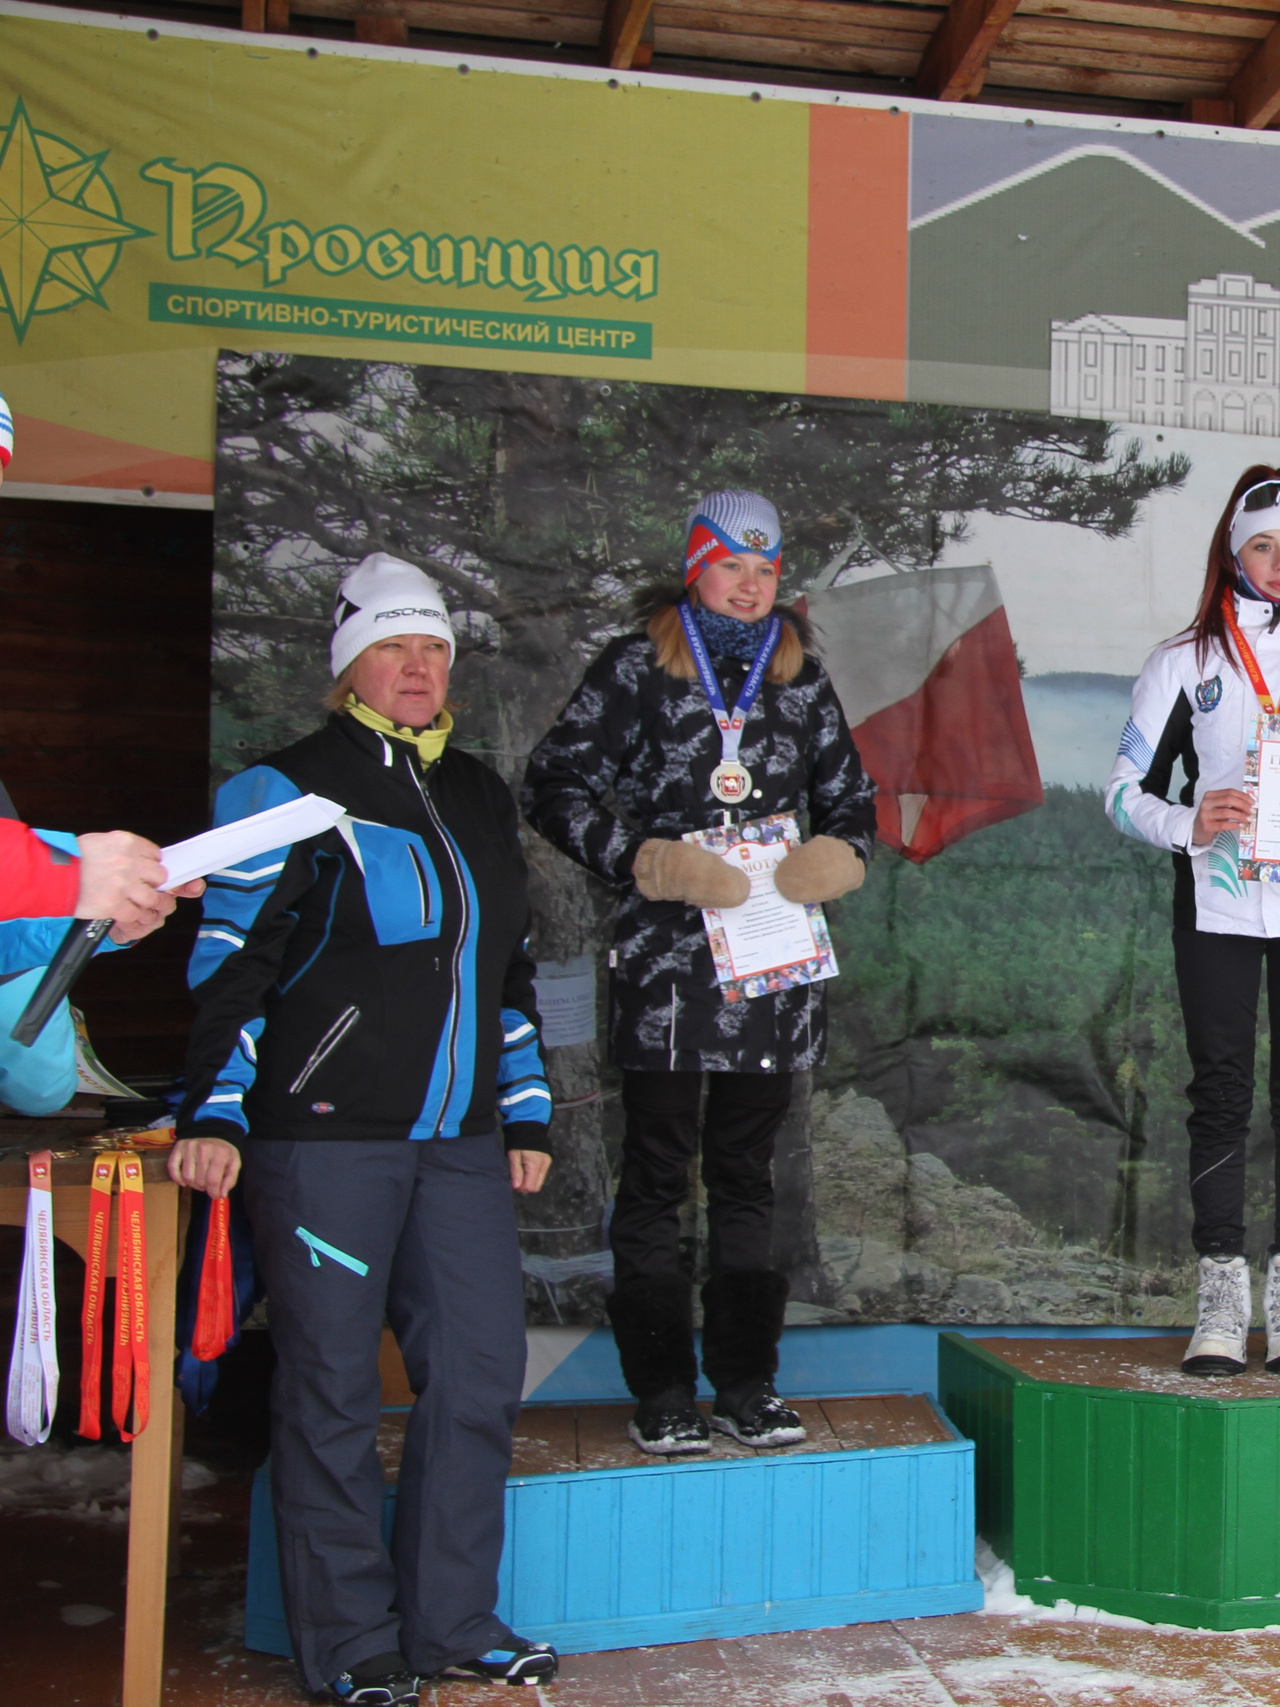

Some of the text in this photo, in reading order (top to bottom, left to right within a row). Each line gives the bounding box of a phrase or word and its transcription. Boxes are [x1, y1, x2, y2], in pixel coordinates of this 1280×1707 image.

[139, 157, 658, 302] Провинция
[167, 295, 636, 349] СПОРТИВНО-ТУРИСТИЧЕСКИЙ ЦЕНТР
[686, 538, 719, 570] RUSSIA
[374, 607, 440, 623] FISCHER
[742, 857, 780, 874] МОТА
[37, 1210, 52, 1342] ЧЕЛЯБИНСКАЯ ОБЛАСТЬ
[86, 1211, 104, 1345] ЧЕЛЯБИНСКАЯ ОБЛАСТЬ
[130, 1210, 145, 1342] ЧЕЛЯБИНСКАЯ ОБЛАСТЬ
